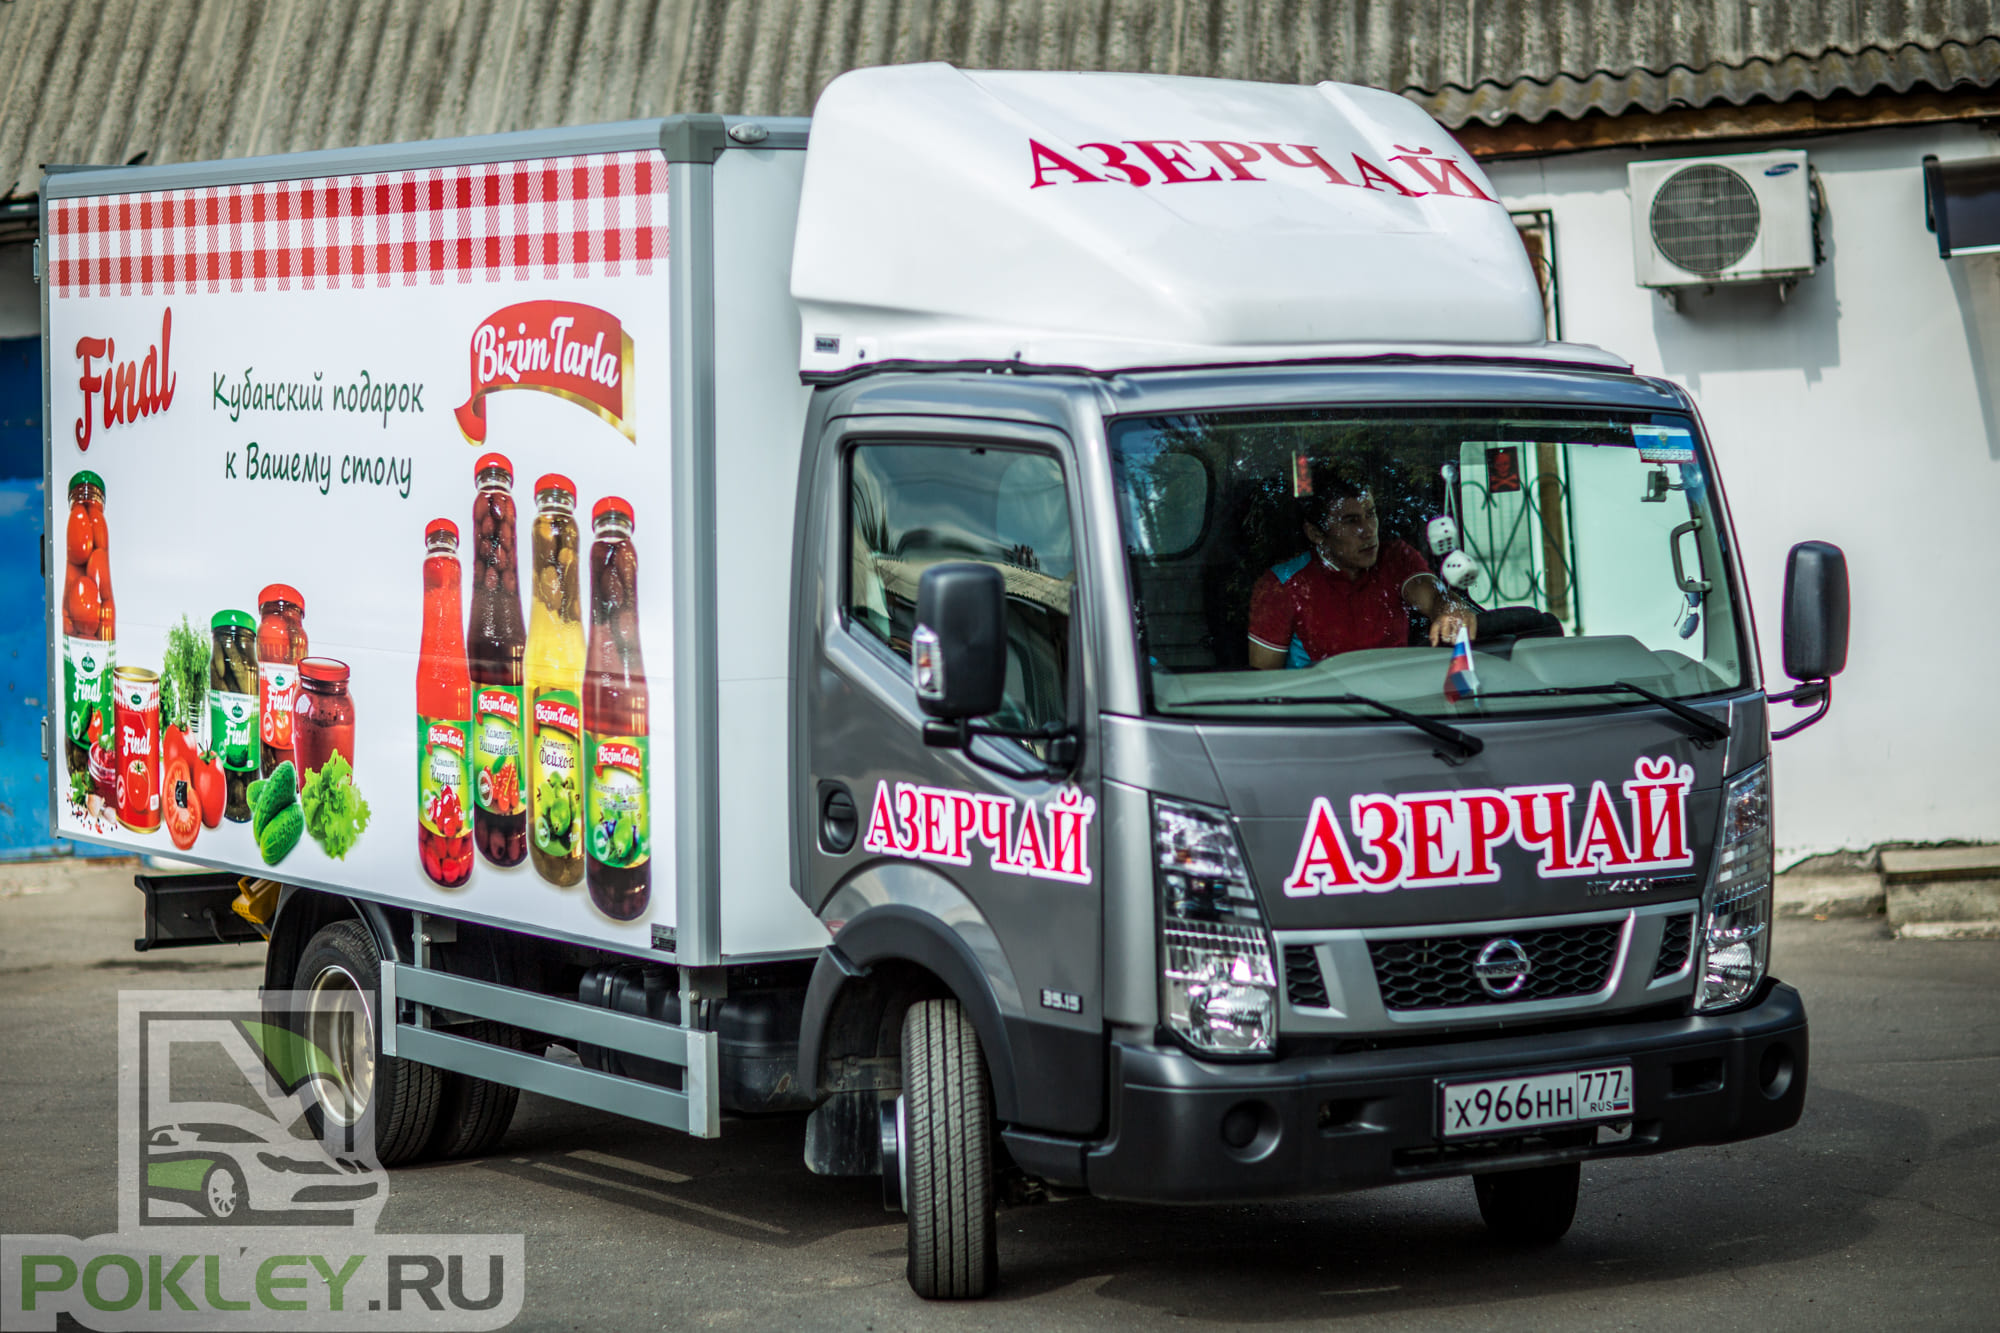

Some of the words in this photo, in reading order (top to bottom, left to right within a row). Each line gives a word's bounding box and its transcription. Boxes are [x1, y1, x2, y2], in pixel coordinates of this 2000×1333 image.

[1029, 137, 1500, 204] АЗЕРЧАЙ
[473, 322, 551, 384] Bizim
[550, 316, 619, 388] Tarla
[75, 306, 177, 452] Final
[213, 366, 324, 423] Кубанский
[332, 369, 424, 429] подарок
[225, 450, 237, 480] к
[245, 441, 331, 496] Вашему
[340, 454, 413, 499] столу
[73, 672, 102, 703] Final
[266, 685, 294, 713] Final
[122, 725, 152, 757] Final
[224, 719, 251, 746] Final
[539, 746, 575, 769] Фейхоа
[865, 781, 1092, 883] АЗЕРЧАЙ
[1286, 757, 1692, 895] АЗЕРЧАЙ
[1578, 1070, 1623, 1103] 777
[1589, 1100, 1614, 1113] RUS
